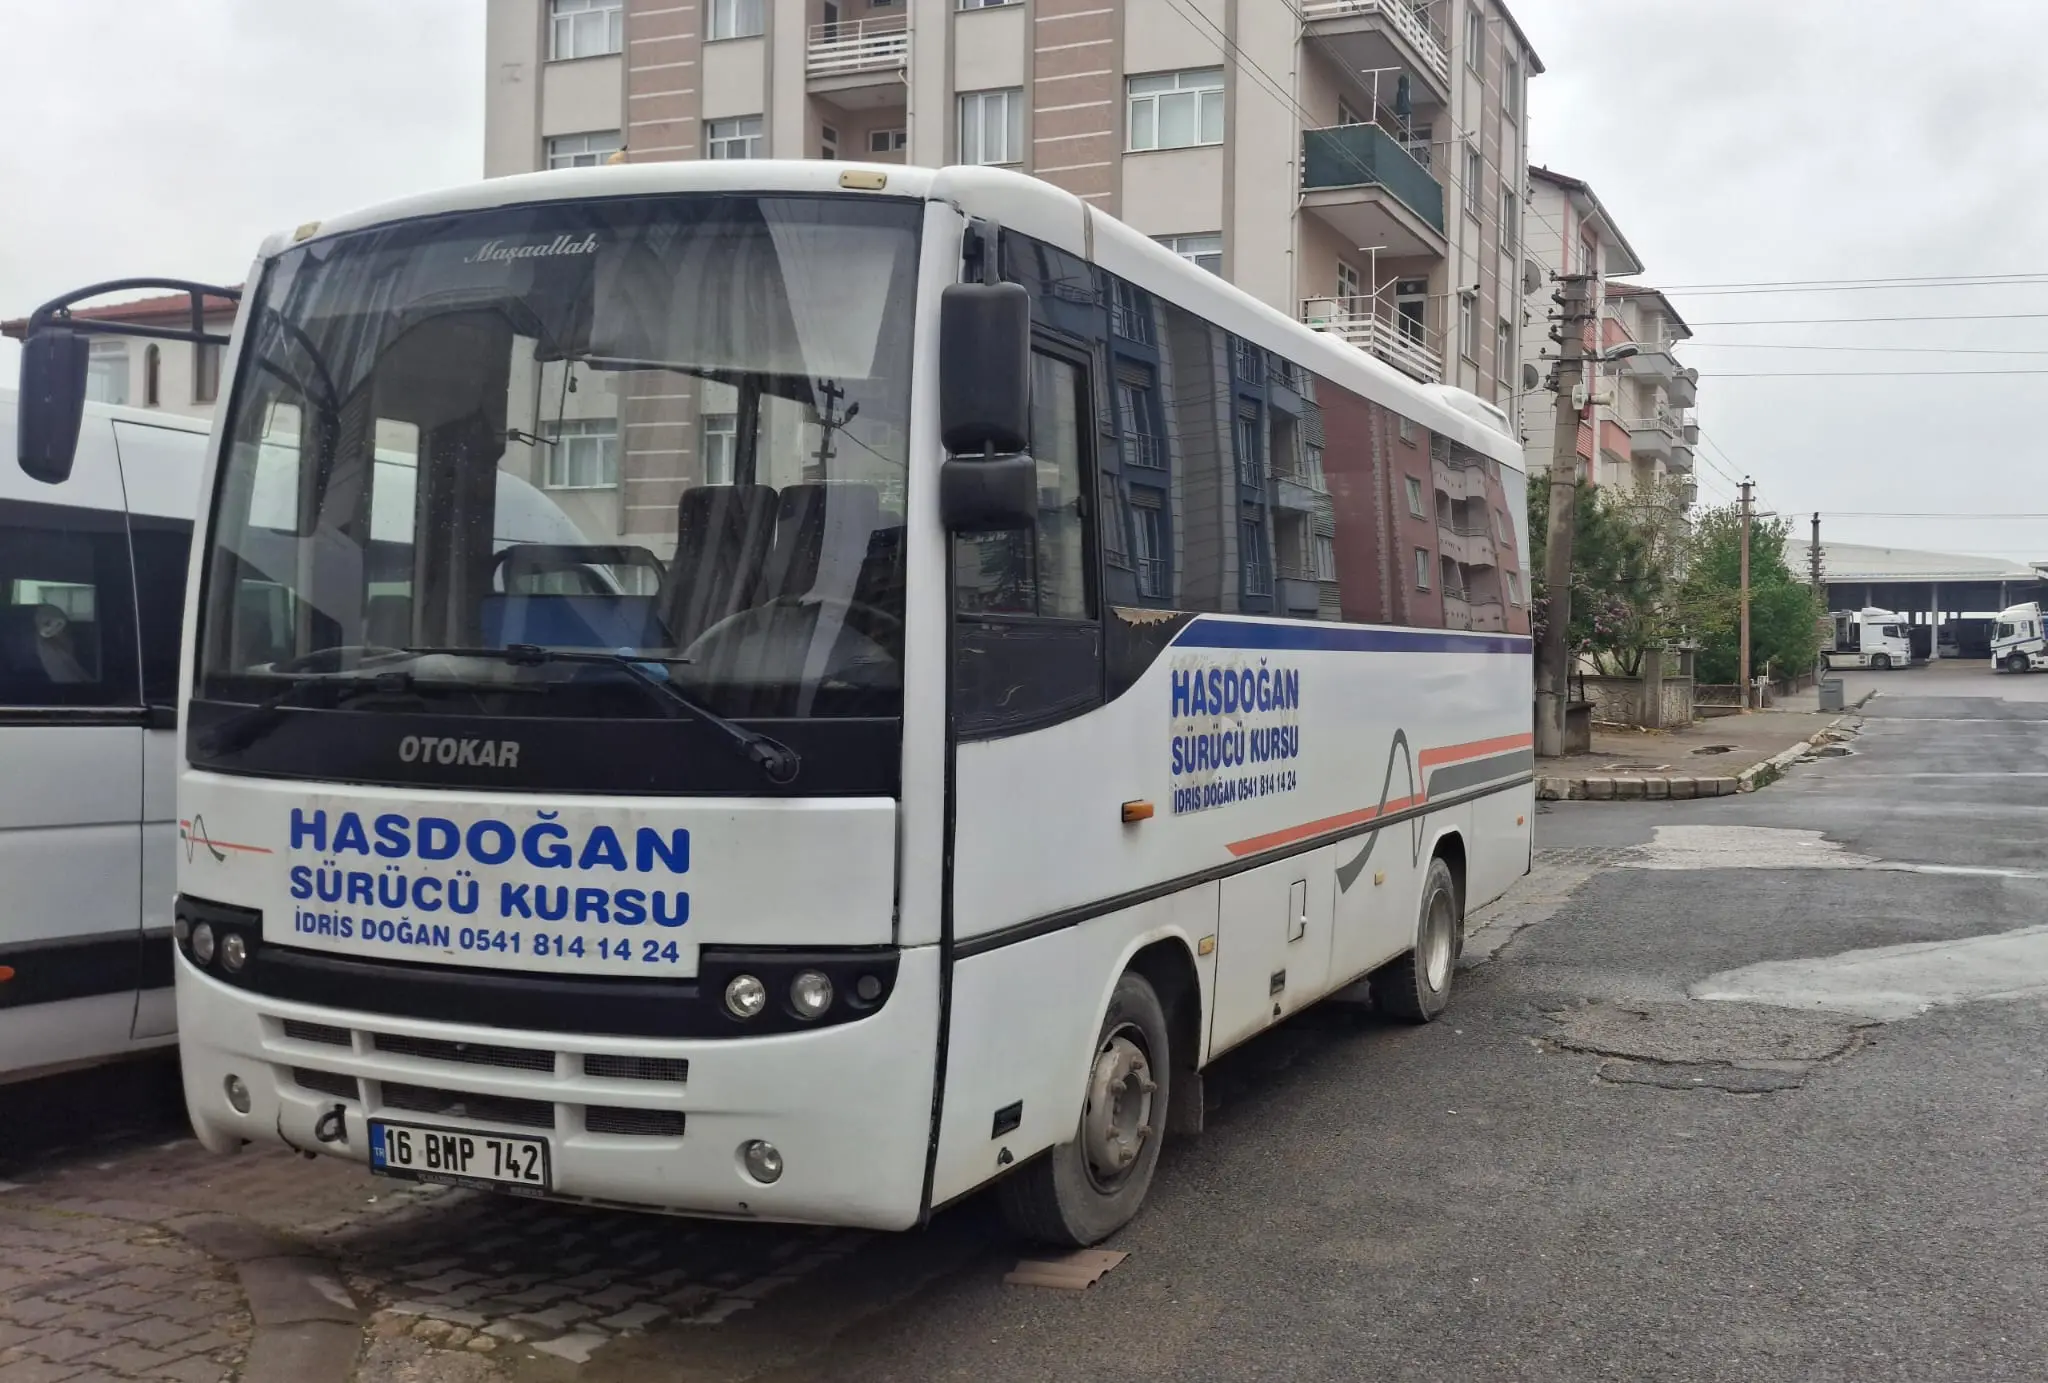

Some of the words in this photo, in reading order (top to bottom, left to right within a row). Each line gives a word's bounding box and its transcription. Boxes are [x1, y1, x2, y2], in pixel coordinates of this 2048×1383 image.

[464, 233, 599, 266] Maşaallah
[1172, 656, 1299, 718] HASDOĞAN
[398, 735, 520, 768] OTOKAR
[1172, 721, 1245, 775] SÜRÜCÜ
[1250, 725, 1299, 763] KURSU
[1174, 781, 1201, 814] İDRİS
[1203, 776, 1236, 808] DOĞAN
[1238, 775, 1257, 801] 0541
[1260, 773, 1275, 797] 814
[1277, 771, 1286, 793] 14
[1287, 770, 1297, 791] 24
[290, 808, 690, 874] HASDOĞAN
[290, 860, 479, 914] SÜRÜCÜ
[500, 882, 690, 927] KURSU
[295, 905, 353, 938] İDRİS
[361, 916, 450, 948] DOĞAN
[459, 927, 521, 953] 0541
[533, 933, 585, 958] 814
[597, 937, 632, 961] 14
[642, 940, 680, 963] 24
[373, 1146, 385, 1159] TR
[385, 1129, 412, 1165] 16
[425, 1134, 474, 1172] BMP
[486, 1141, 539, 1180] 742
